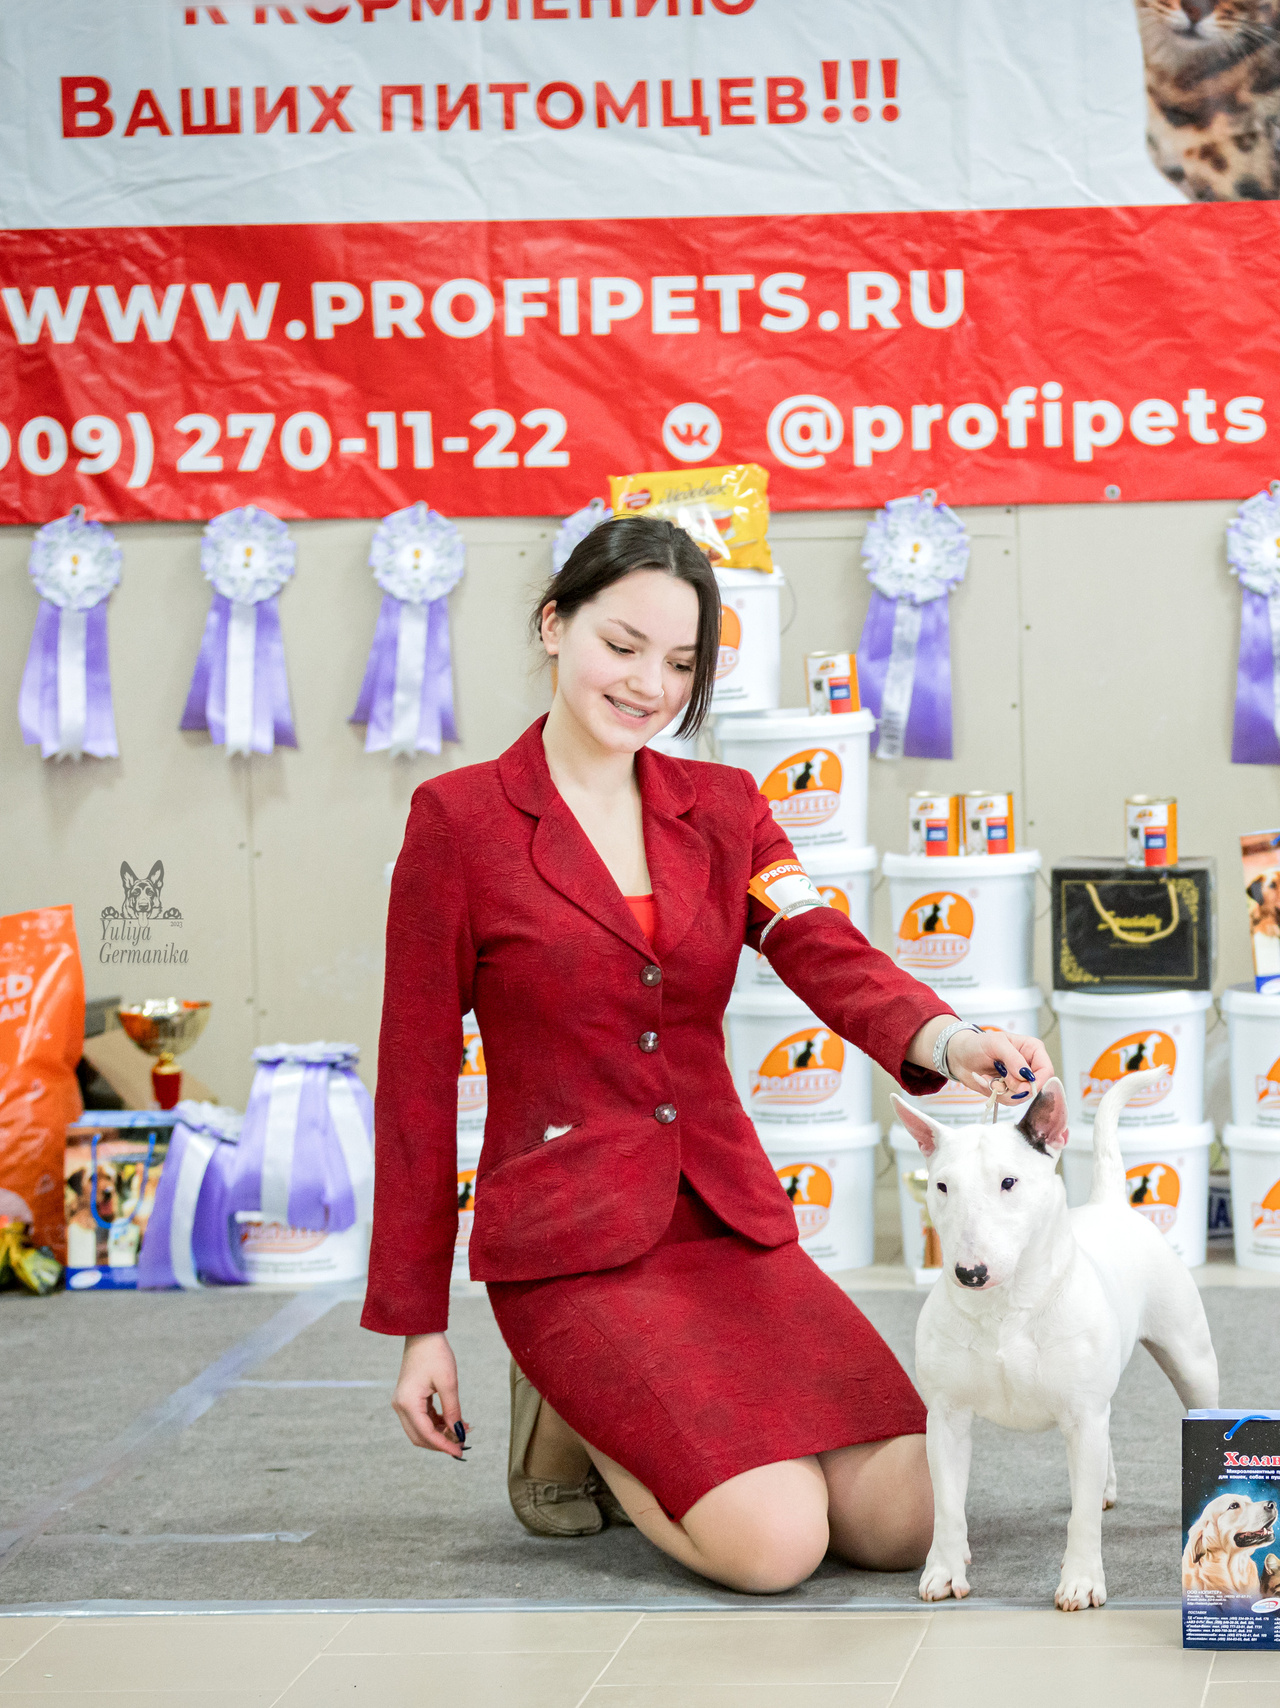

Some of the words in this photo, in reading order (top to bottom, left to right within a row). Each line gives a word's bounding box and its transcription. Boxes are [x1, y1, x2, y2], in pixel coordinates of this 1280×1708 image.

[2, 270, 965, 345] WWW.PROFIPETS.RU
[0, 413, 154, 489] 09)
[174, 408, 570, 473] 270-11-22
[767, 381, 1267, 470] @profipets
